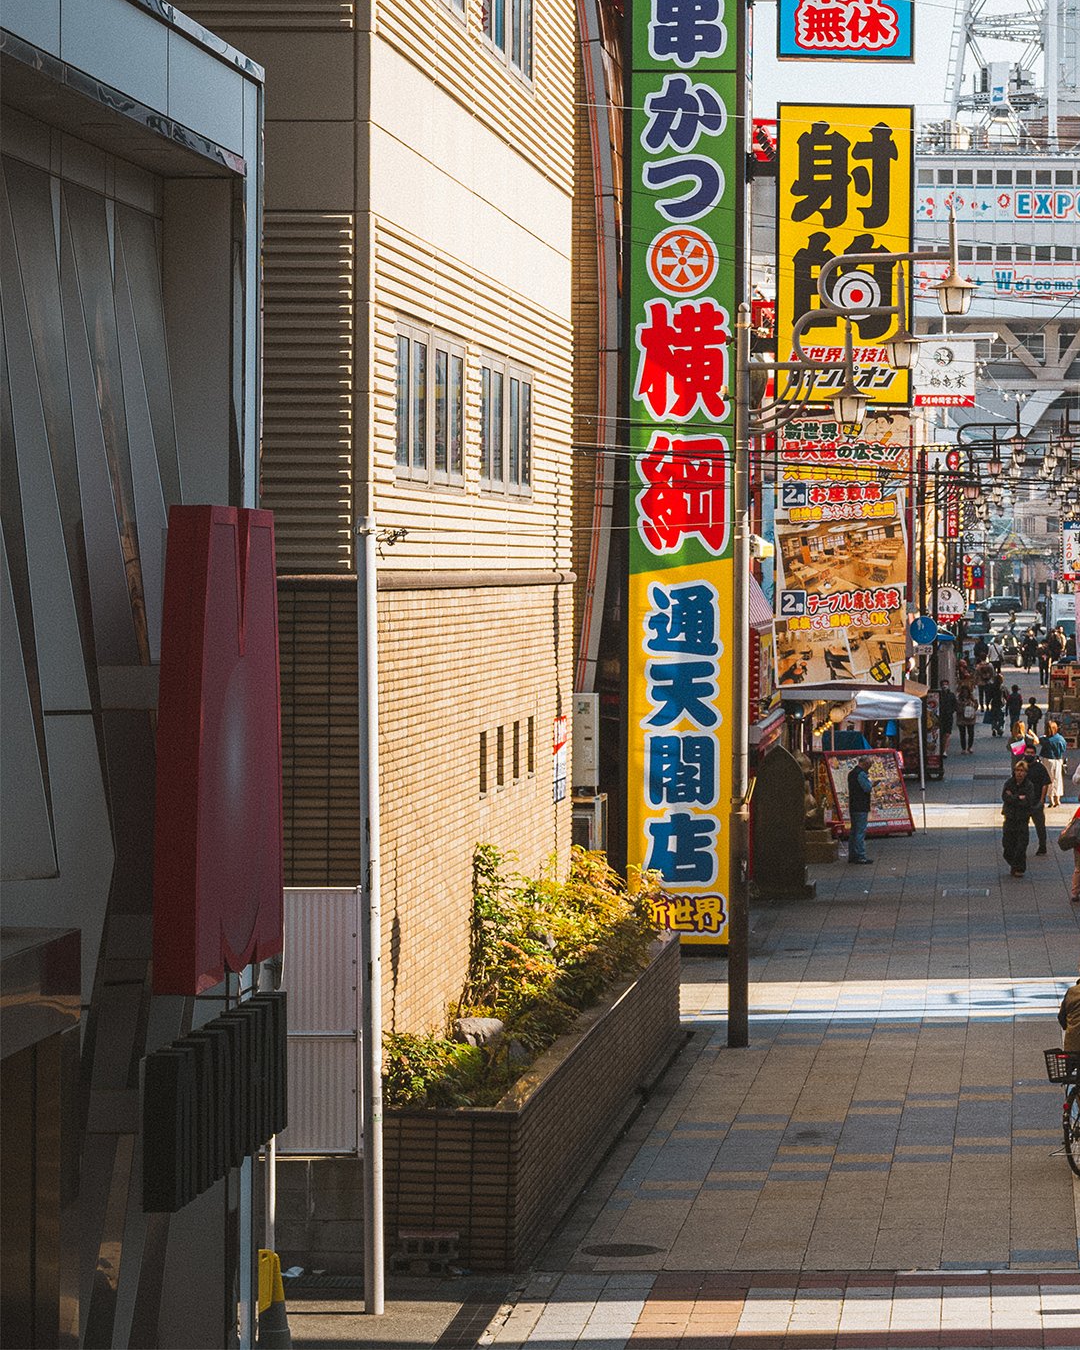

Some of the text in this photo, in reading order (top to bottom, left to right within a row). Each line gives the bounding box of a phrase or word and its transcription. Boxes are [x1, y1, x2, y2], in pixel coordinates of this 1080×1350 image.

[801, 5, 892, 43] 無休
[790, 120, 899, 340] 射的
[634, 300, 733, 552] 横綱
[784, 422, 838, 440] 新世界
[784, 486, 805, 503] 2
[782, 593, 804, 613] 2
[645, 583, 720, 884] 通天閣店
